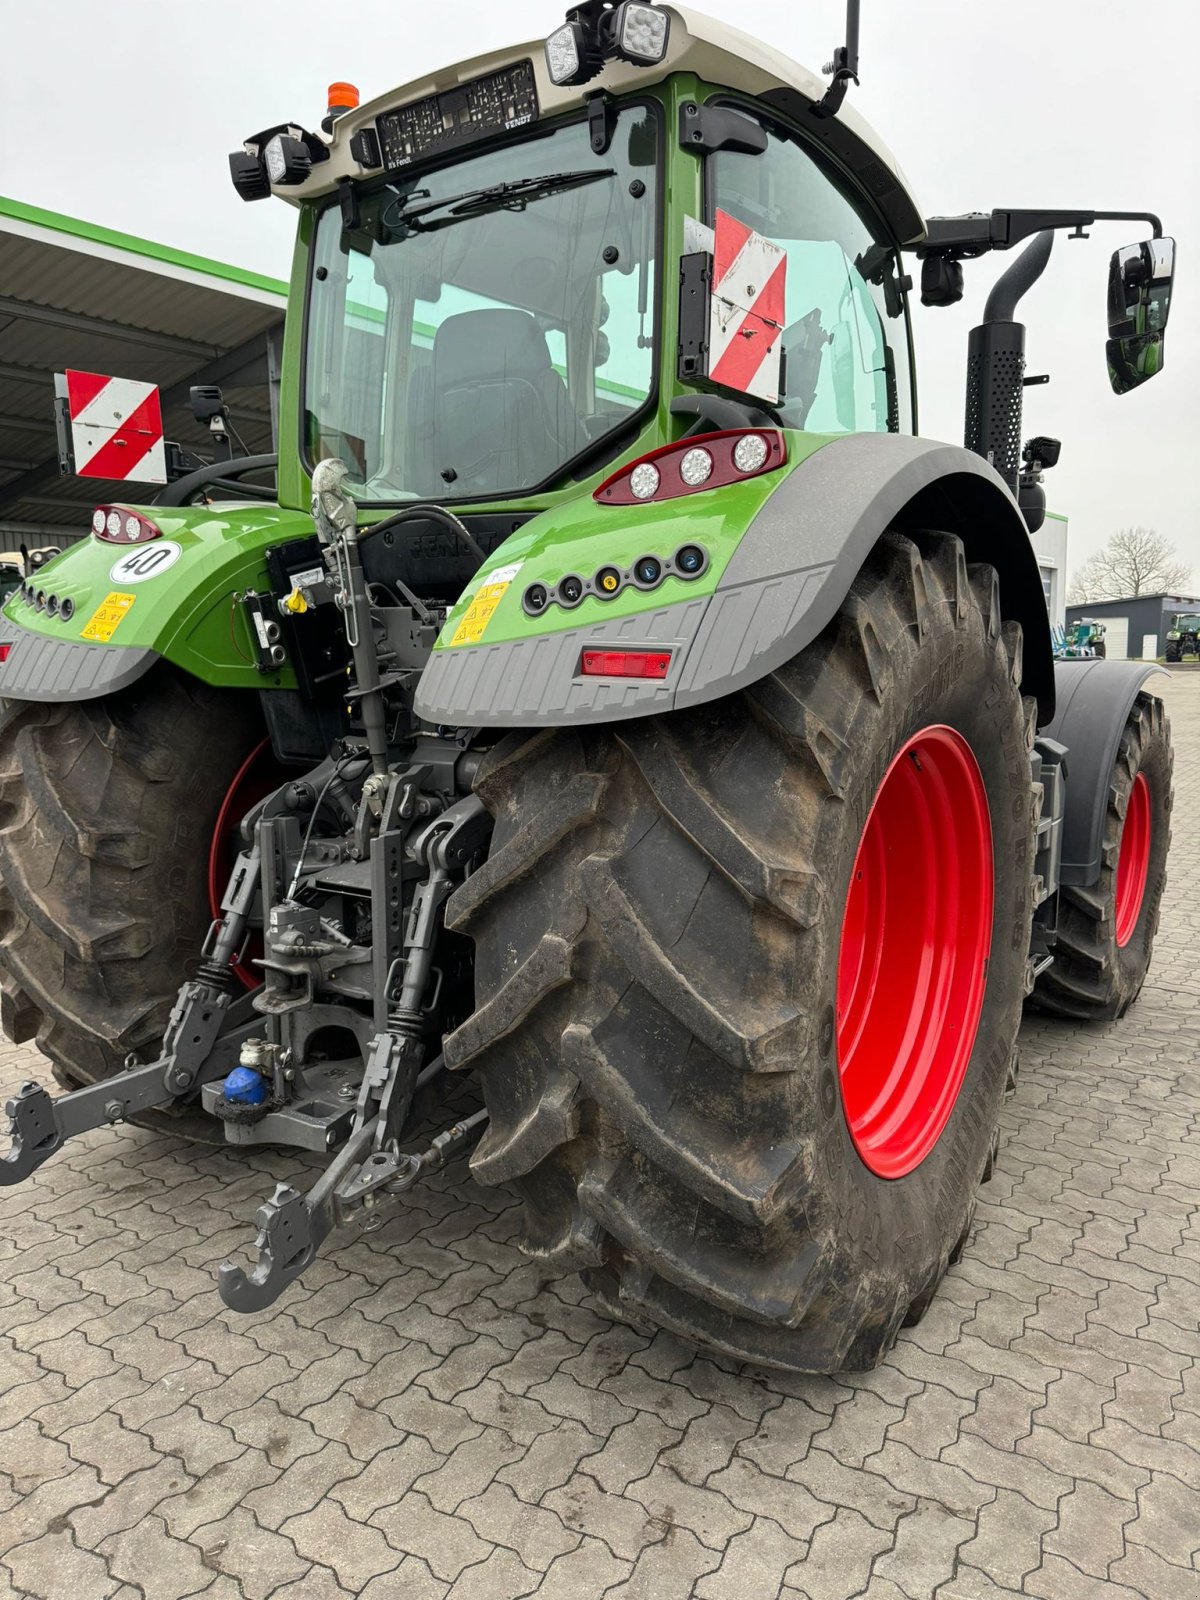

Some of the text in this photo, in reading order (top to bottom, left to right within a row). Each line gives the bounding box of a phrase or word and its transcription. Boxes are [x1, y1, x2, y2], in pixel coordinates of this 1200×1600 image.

[504, 113, 532, 130] FENDT
[388, 160, 396, 170] It's
[121, 546, 172, 576] 40
